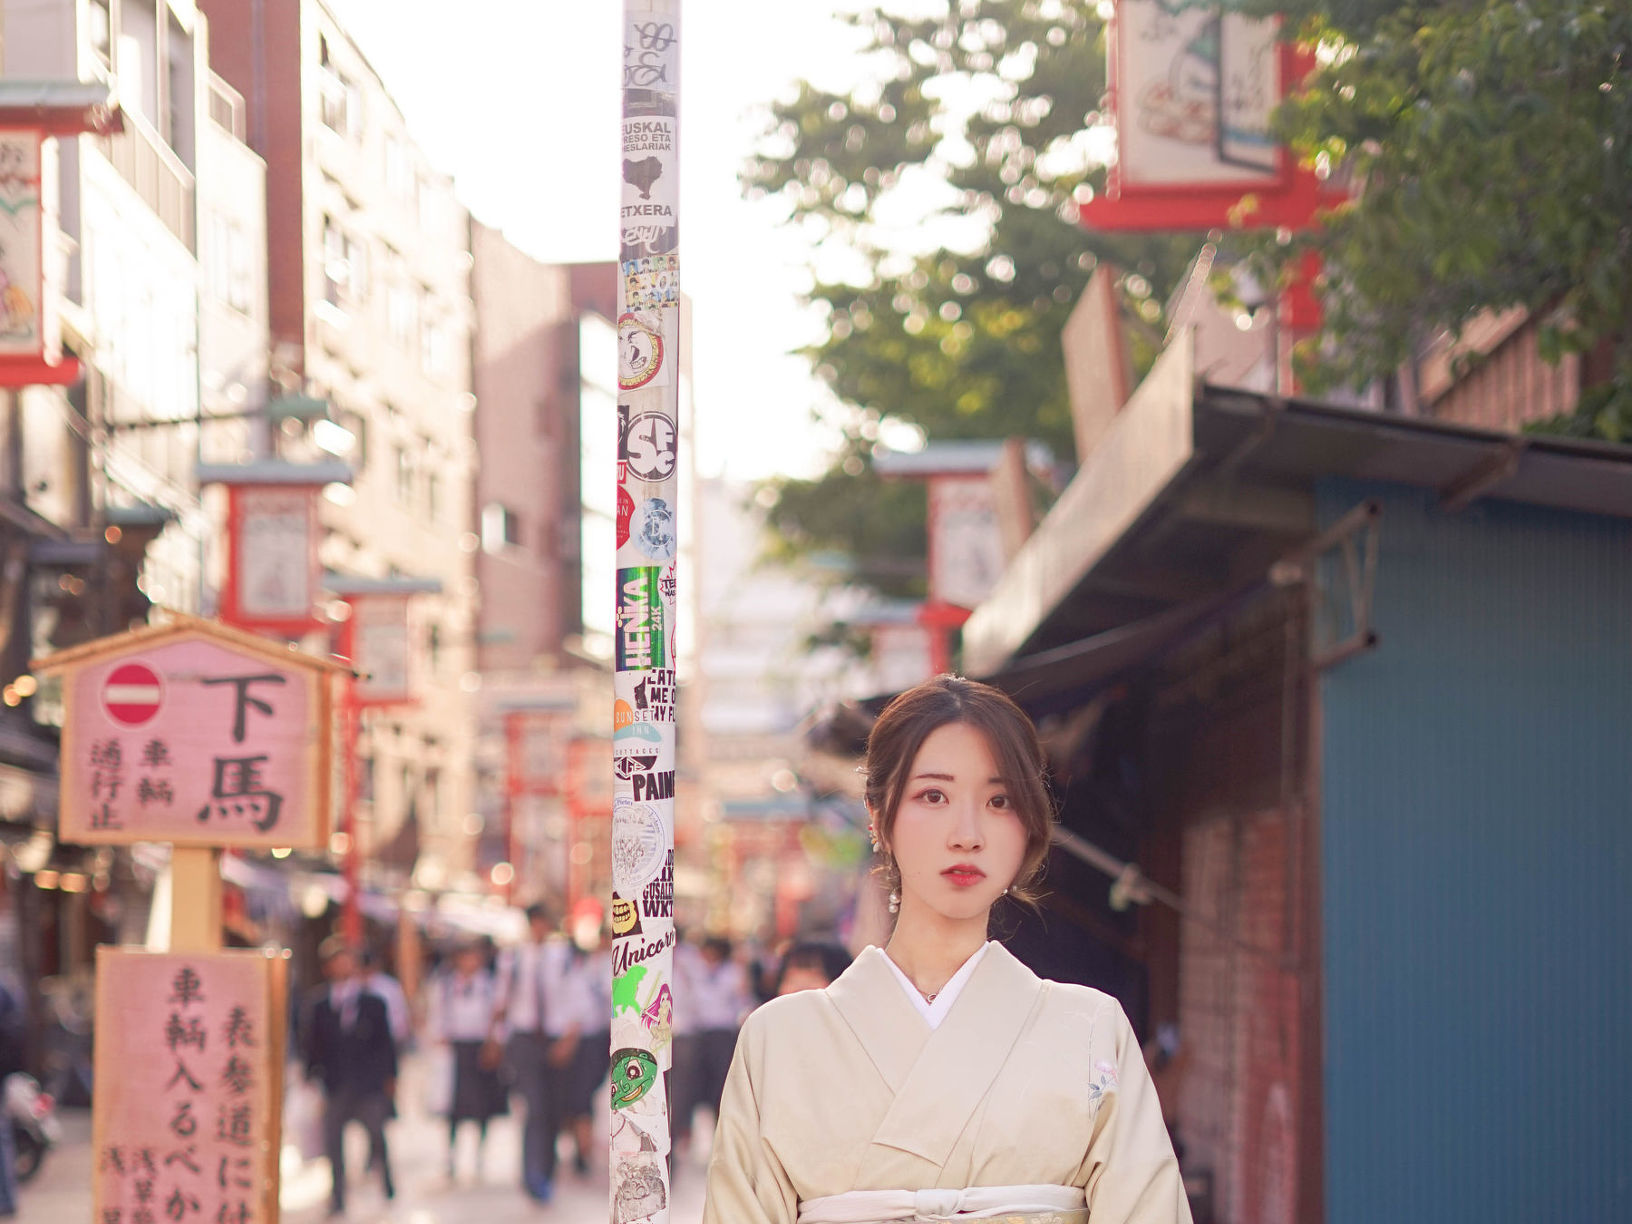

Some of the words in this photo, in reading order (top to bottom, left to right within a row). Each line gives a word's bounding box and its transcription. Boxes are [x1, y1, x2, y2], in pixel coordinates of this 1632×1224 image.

[652, 133, 671, 142] ETA
[621, 204, 672, 218] ETXERA
[197, 674, 286, 833] 下馬
[88, 738, 123, 832] 通行止
